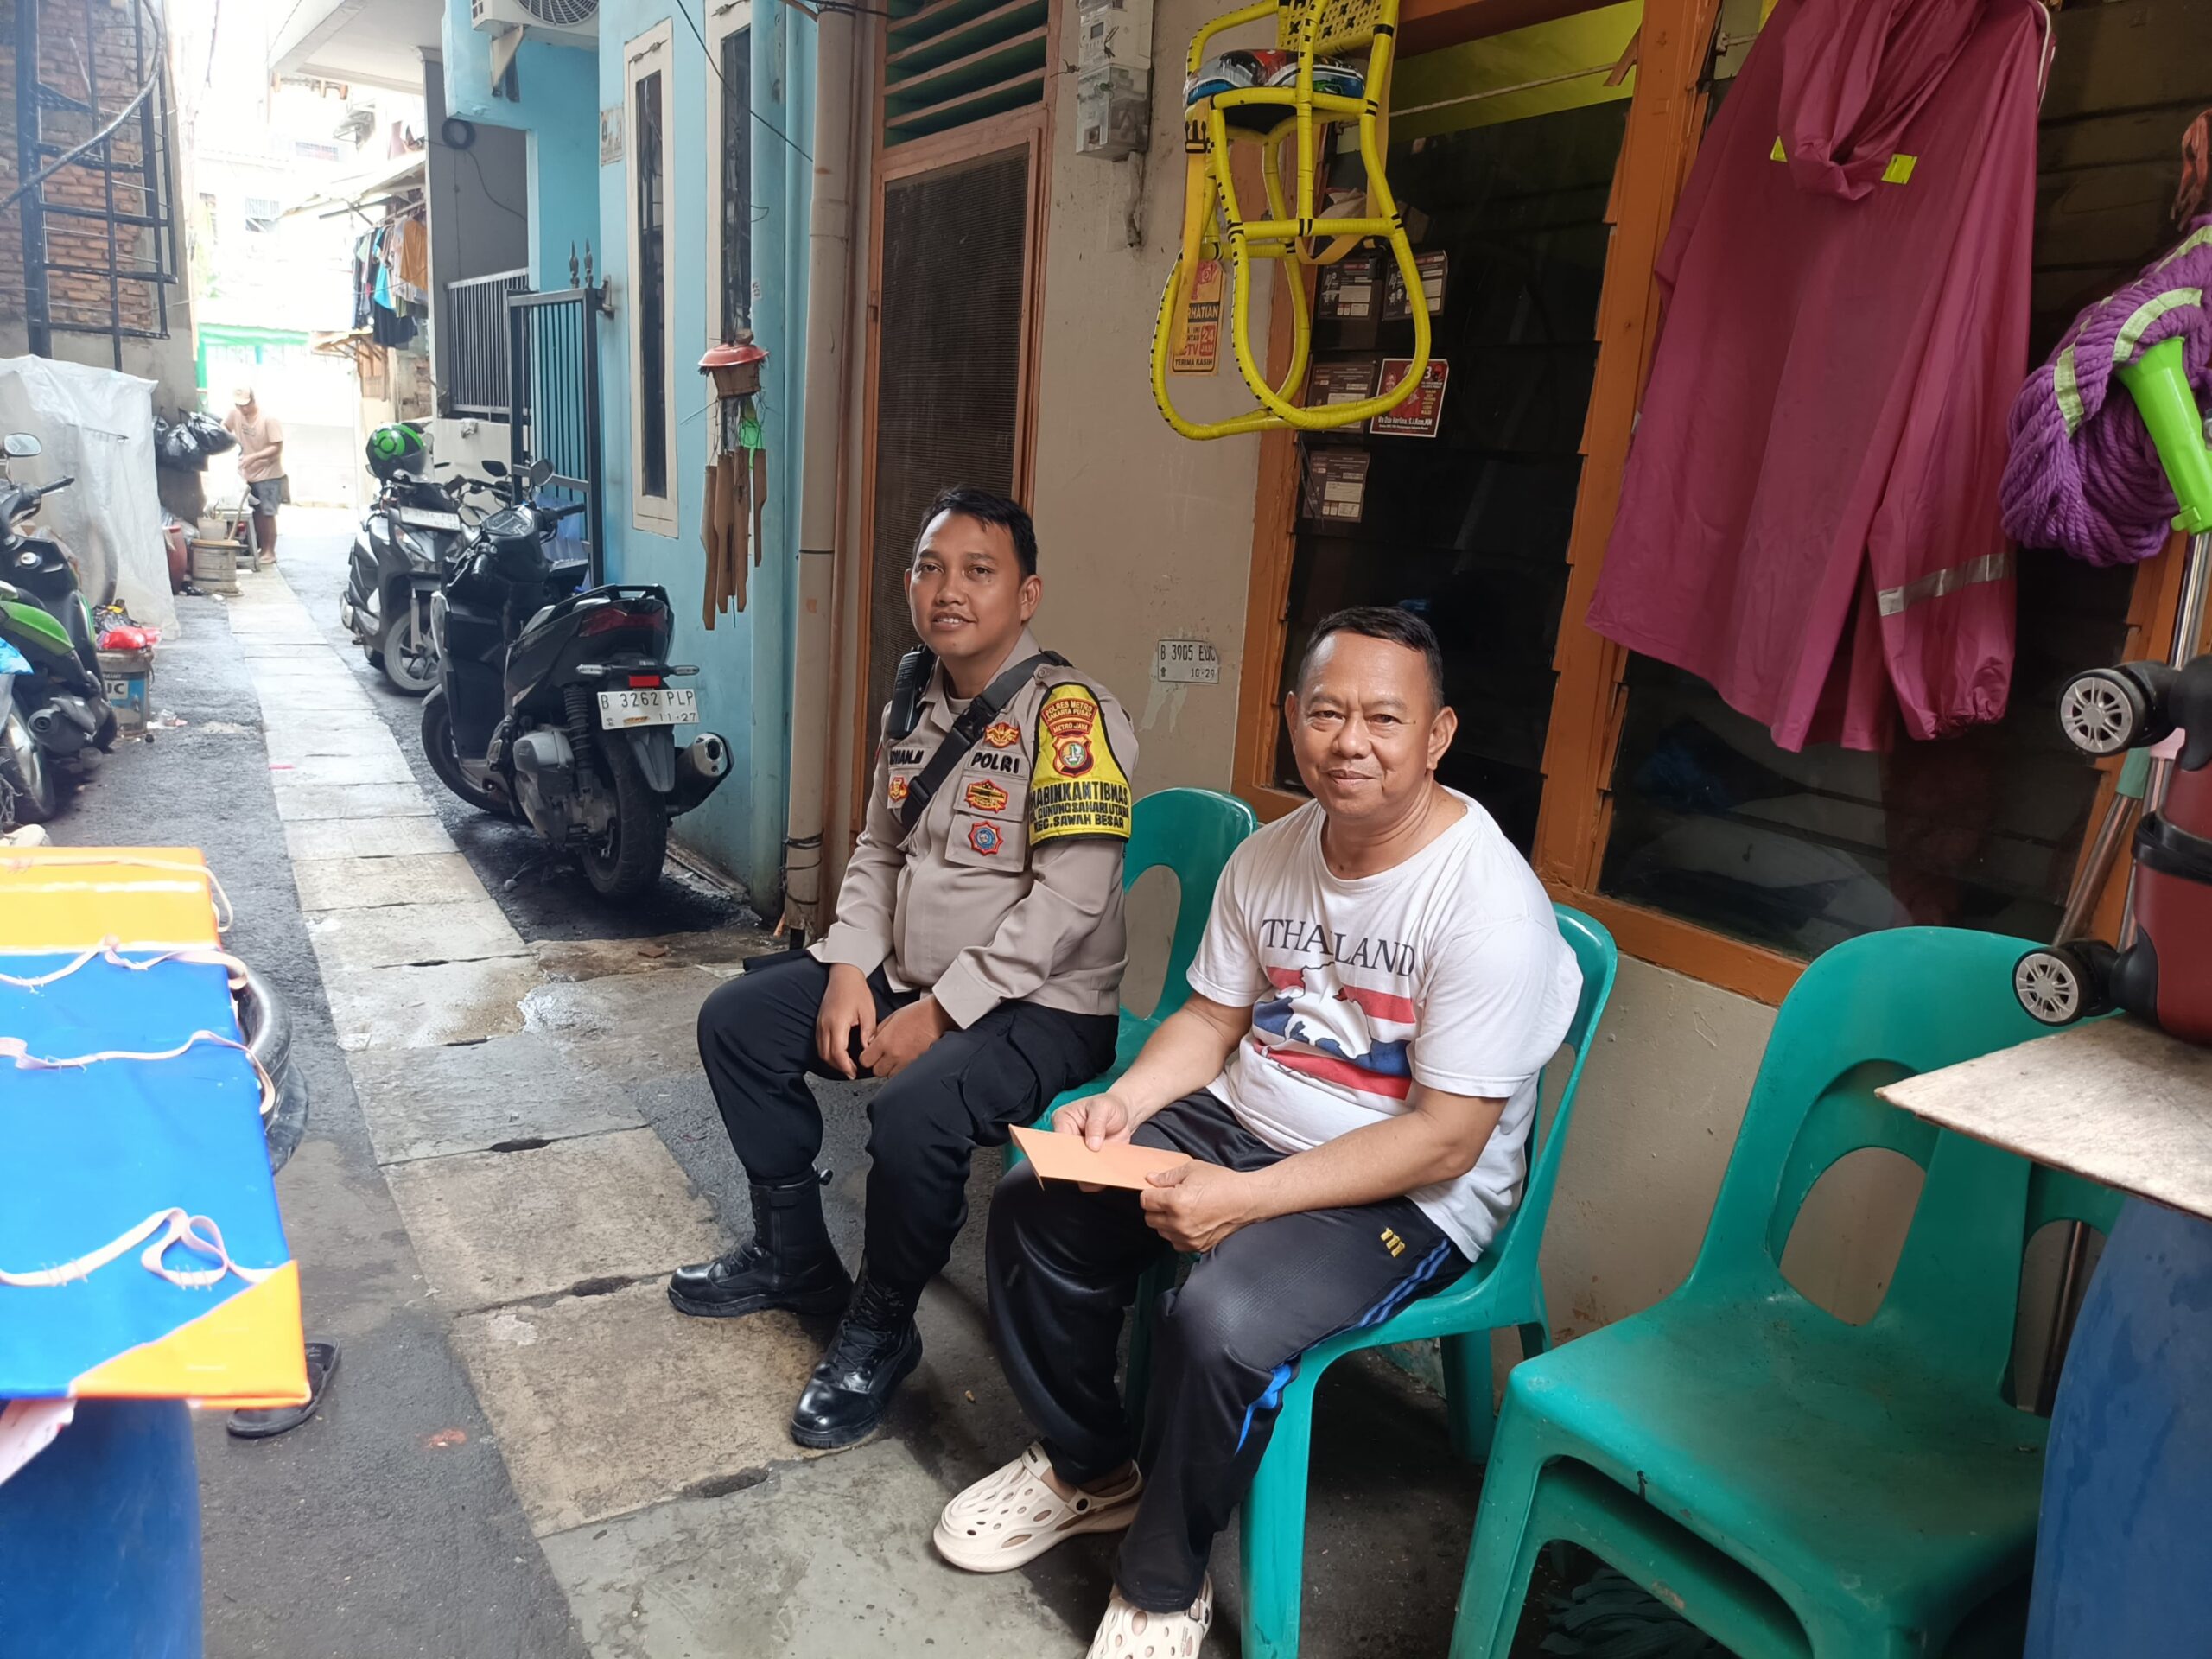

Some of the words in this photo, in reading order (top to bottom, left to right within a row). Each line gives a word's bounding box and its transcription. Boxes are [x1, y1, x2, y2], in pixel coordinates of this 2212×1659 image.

[1188, 305, 1219, 319] RHATIAN
[1201, 328, 1215, 343] 24
[1160, 645, 1166, 660] B
[1172, 645, 1193, 661] 3905
[601, 694, 609, 709] B
[620, 692, 659, 708] 3262
[667, 691, 693, 706] PLP
[1046, 701, 1069, 716] POLRES
[1070, 700, 1093, 712] METRO
[1047, 709, 1071, 721] JAKARTA
[1073, 709, 1092, 719] PUSAT
[1053, 722, 1072, 733] METRO
[1073, 721, 1088, 732] JAYA
[970, 752, 1020, 774] POLRI
[1072, 801, 1108, 814] SAHARI
[1095, 814, 1124, 829] BESAR
[1261, 918, 1415, 977] THALAND
